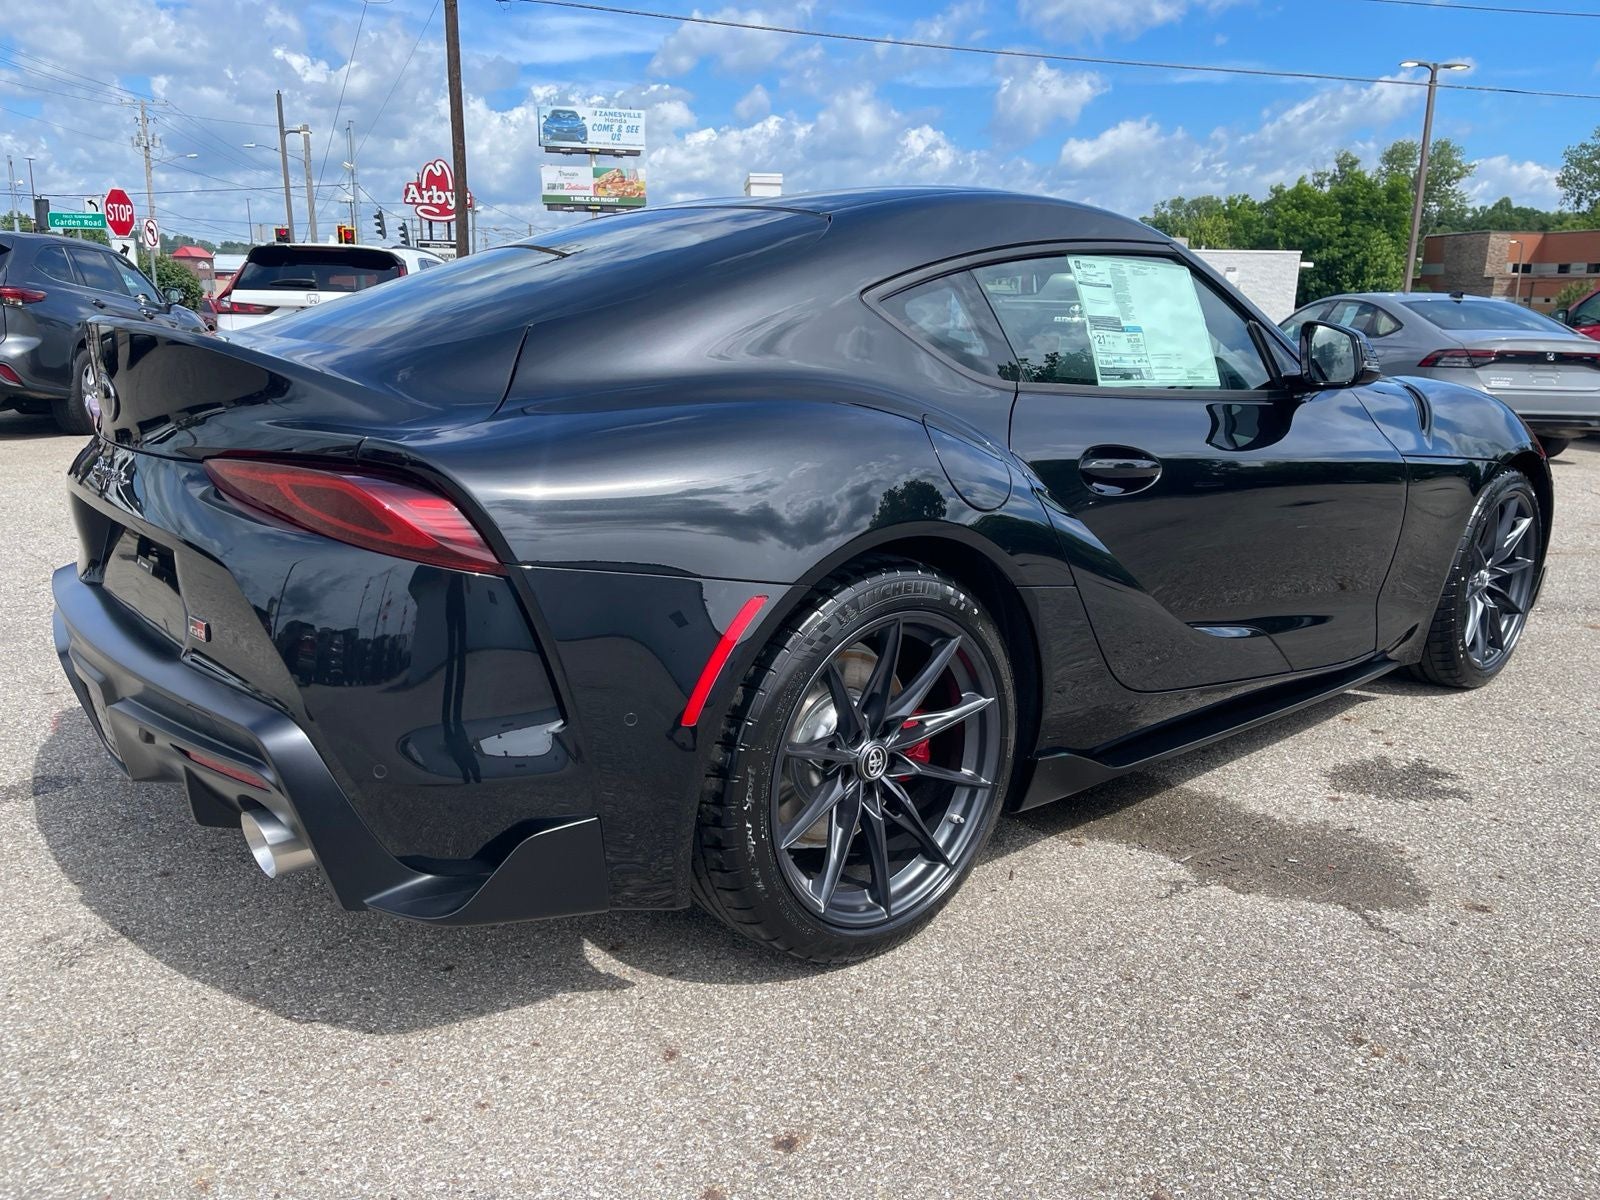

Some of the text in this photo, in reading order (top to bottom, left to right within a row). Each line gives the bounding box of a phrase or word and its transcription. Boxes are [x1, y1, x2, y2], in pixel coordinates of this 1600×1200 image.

[599, 110, 642, 119] ZANESVILLE
[592, 123, 640, 134] COME & SEE
[611, 133, 622, 141] US
[405, 184, 470, 210] Arby
[107, 203, 133, 222] STOP
[84, 219, 102, 227] Road
[1097, 334, 1106, 345] 21
[858, 581, 941, 609] MICHELIN
[190, 624, 206, 642] GR
